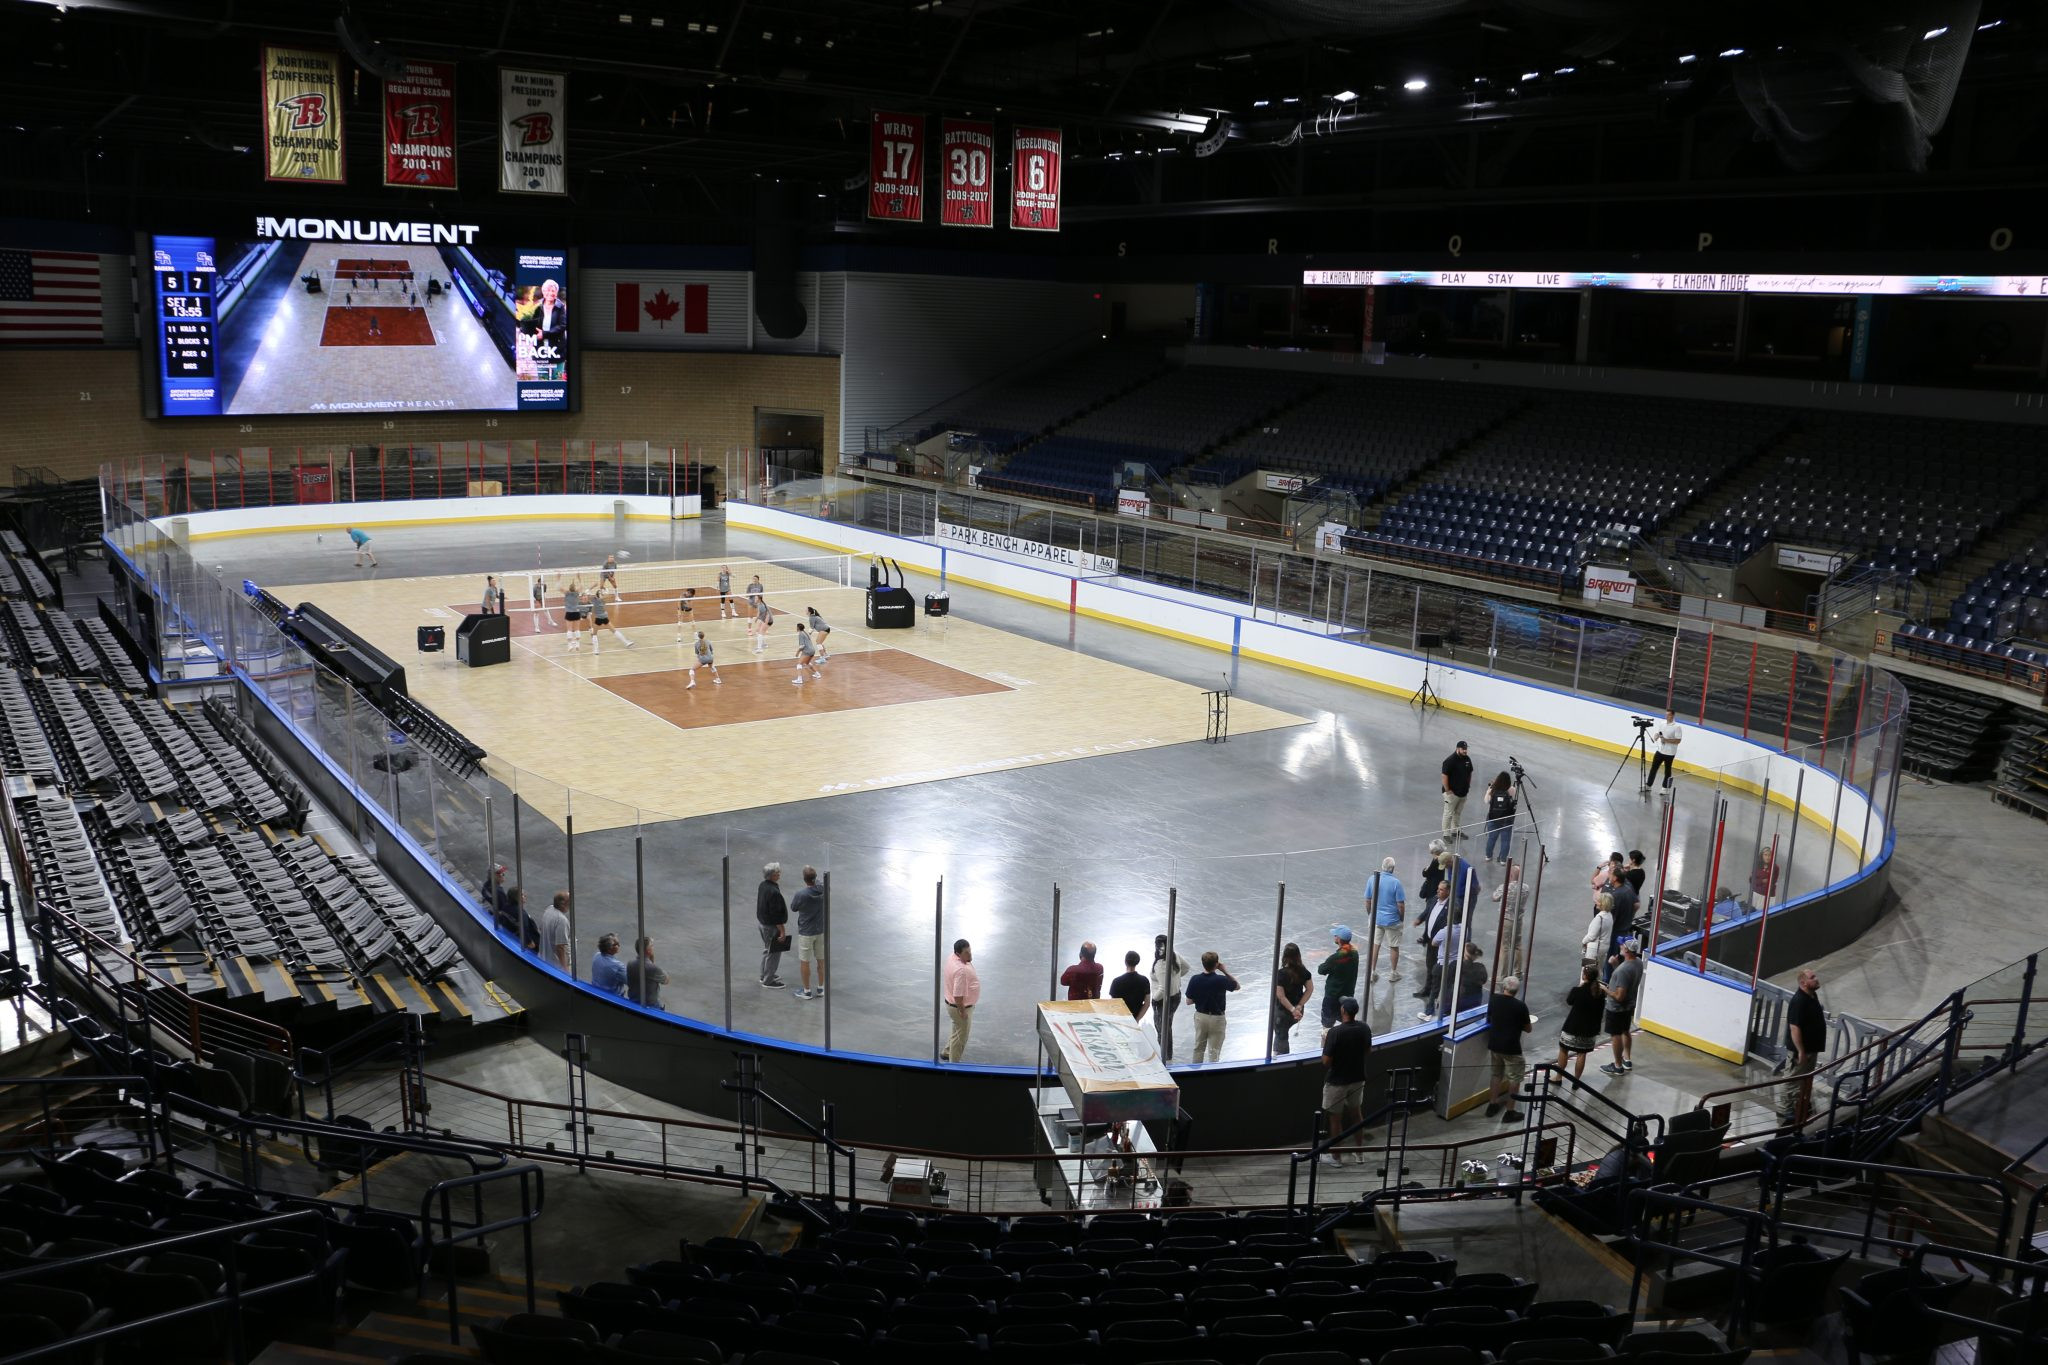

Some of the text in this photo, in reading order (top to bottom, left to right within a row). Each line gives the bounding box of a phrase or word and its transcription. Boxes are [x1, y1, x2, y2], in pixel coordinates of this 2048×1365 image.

[277, 56, 329, 70] NORTHERN
[272, 70, 335, 86] CONFERENCE
[514, 74, 528, 84] RAY
[388, 84, 451, 97] REGULAR SEASON
[527, 98, 541, 107] CUP
[883, 122, 914, 139] WRAY
[272, 136, 339, 151] CHAMPIONS
[944, 130, 991, 149] BATTOCHIO
[1015, 137, 1059, 155] WESELOWSKI
[389, 142, 452, 158] CHAMPIONS
[294, 152, 319, 164] 2010
[402, 158, 441, 171] 2010-11
[505, 151, 562, 166] CHAMPIONS
[882, 140, 914, 180] 17
[523, 166, 545, 177] 2010
[950, 148, 986, 187] 30
[1028, 154, 1045, 191] 6
[874, 182, 919, 197] 2009-2014
[946, 189, 989, 202] 2009-2017
[256, 217, 479, 245] THE MONUMENT
[1267, 237, 1278, 255] R
[1448, 234, 1462, 256] Q
[1697, 231, 1712, 252] P
[1990, 227, 2013, 251] O
[1117, 241, 1127, 256] S
[168, 277, 177, 289] 5
[193, 278, 202, 289] 7
[1322, 271, 1374, 285] ELKHORN RIDGE
[1441, 273, 1467, 284] PLAY
[1487, 273, 1514, 284] STAY
[1536, 273, 1560, 285] LIVE
[1672, 274, 1750, 291] ELKHORN RIDGE
[166, 297, 200, 307] SET 1
[172, 306, 203, 317] 13:55
[179, 325, 197, 333] KILLS
[518, 333, 538, 347] I'M
[518, 346, 560, 359] BACK.
[80, 391, 91, 401] 21
[621, 386, 632, 394] 17
[329, 399, 455, 410] MONUMENT HEALTH
[240, 424, 252, 433] 20
[382, 420, 394, 430] 19
[485, 418, 498, 427] 18
[951, 525, 1074, 564] PARK BENCH APPAREL
[1586, 578, 1634, 593] BRANDT
[1050, 737, 1159, 759] HEALTH
[1067, 1016, 1133, 1073] Fusion
